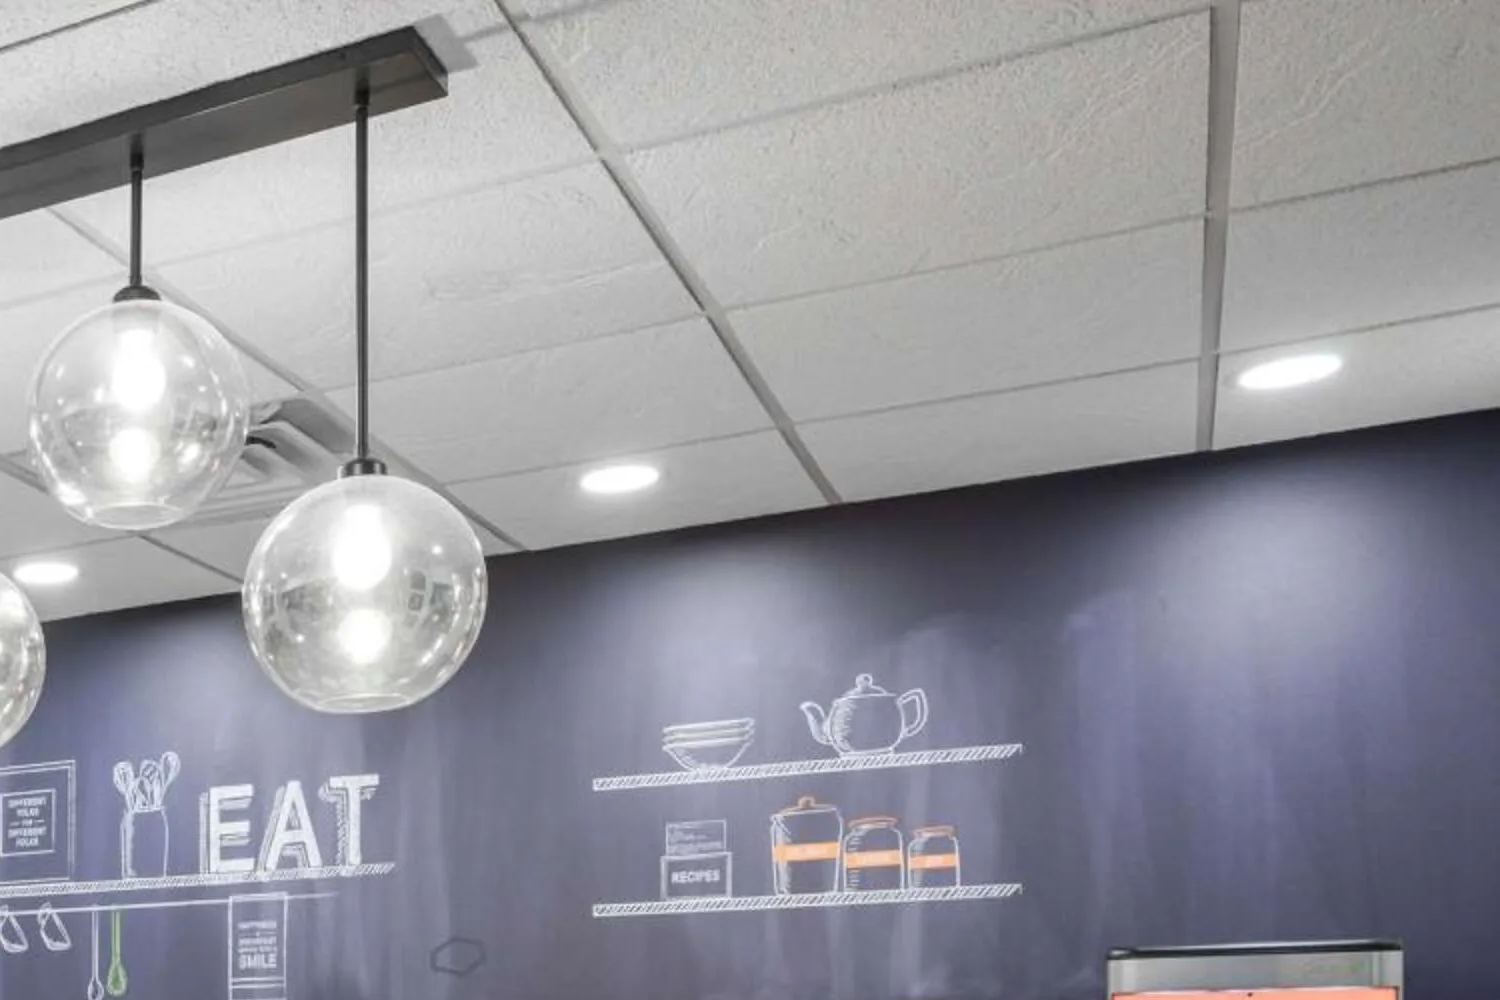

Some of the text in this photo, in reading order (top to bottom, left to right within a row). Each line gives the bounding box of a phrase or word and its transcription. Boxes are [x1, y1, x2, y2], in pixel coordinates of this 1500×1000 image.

[199, 773, 380, 874] EAT
[671, 869, 720, 884] RECIPES
[239, 954, 277, 969] SMILE
